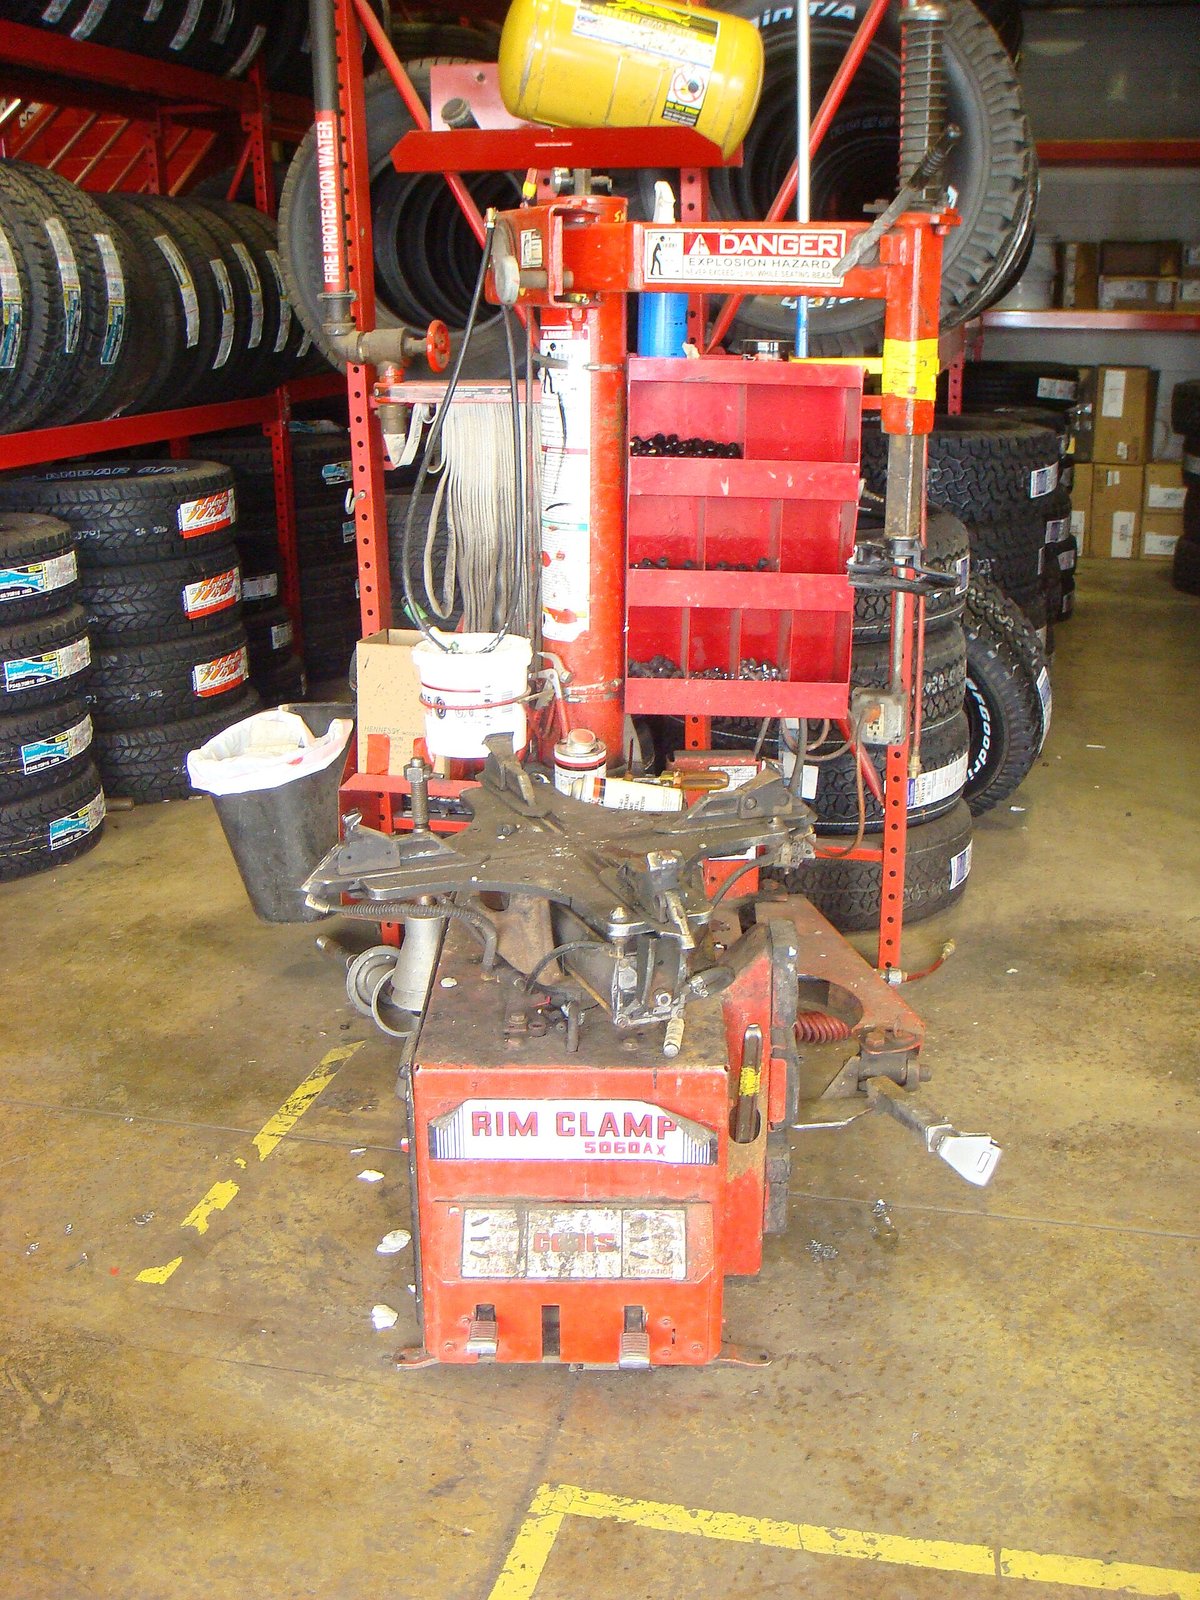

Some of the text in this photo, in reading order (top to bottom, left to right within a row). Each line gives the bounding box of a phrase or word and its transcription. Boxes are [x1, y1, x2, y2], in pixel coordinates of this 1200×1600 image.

[316, 121, 340, 283] FIRE PROTECTION WATER
[719, 234, 839, 255] DANGER
[689, 256, 831, 270] EXPLOSION HAZARD
[472, 1111, 677, 1139] RIM CLAMP
